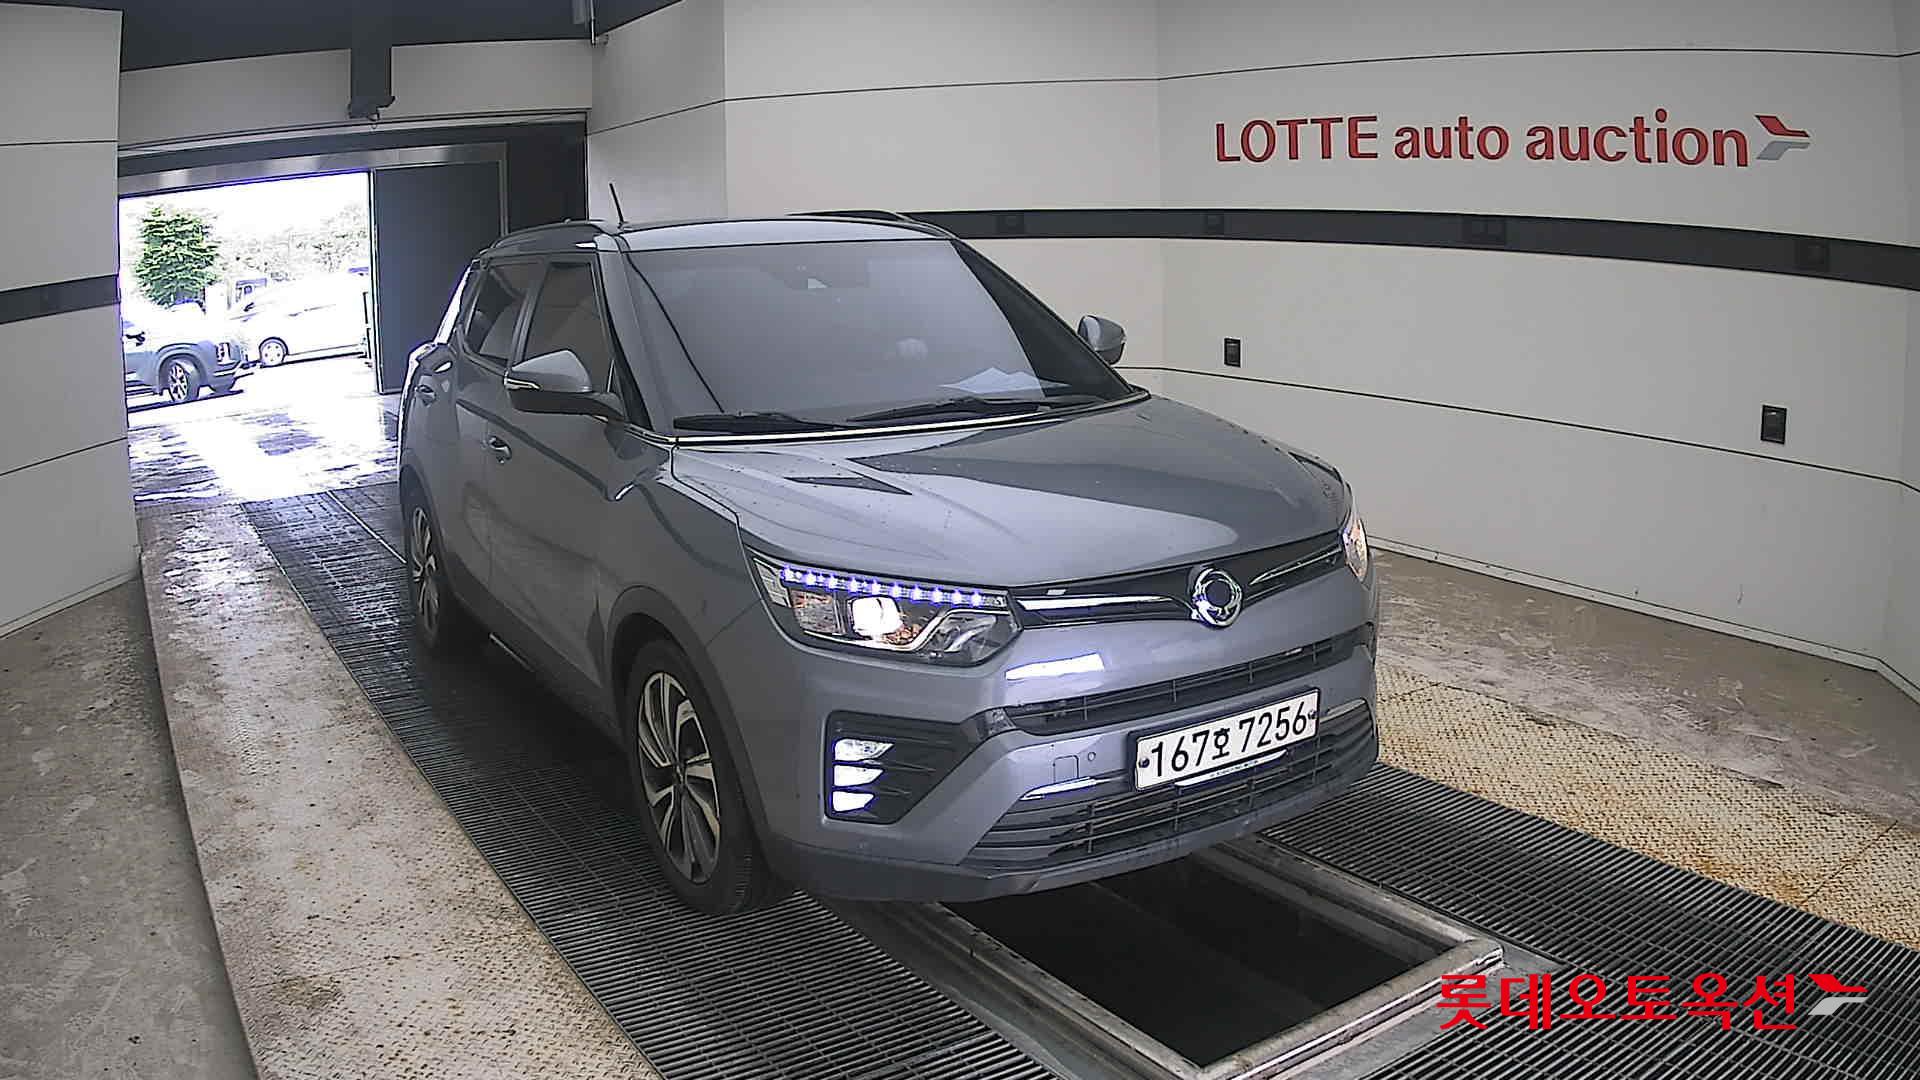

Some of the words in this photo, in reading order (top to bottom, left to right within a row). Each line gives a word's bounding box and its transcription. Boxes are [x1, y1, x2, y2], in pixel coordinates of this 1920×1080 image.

[1216, 116, 1379, 162] LOTTE
[1394, 117, 1510, 160] auto
[1525, 108, 1748, 167] auction
[1151, 727, 1230, 777] 167호
[1239, 701, 1307, 752] 7256
